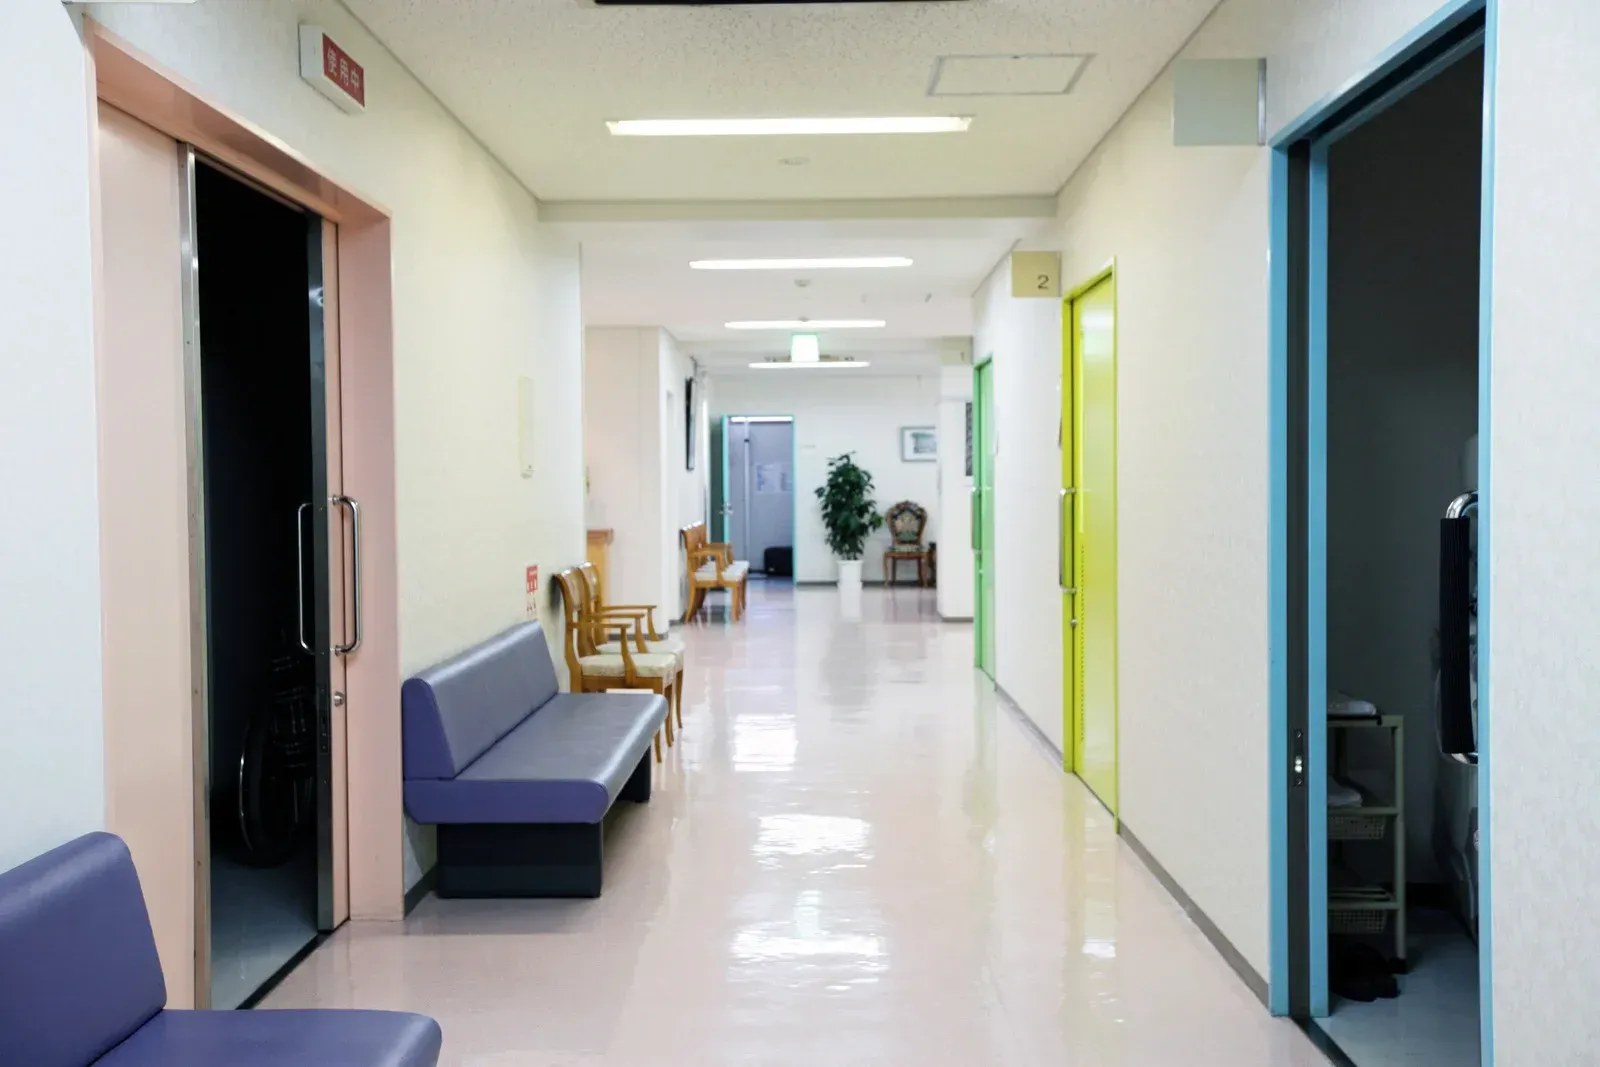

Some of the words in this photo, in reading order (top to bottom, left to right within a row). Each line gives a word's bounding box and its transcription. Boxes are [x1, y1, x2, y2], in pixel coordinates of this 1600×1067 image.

[326, 45, 360, 92] 使用中
[1037, 274, 1049, 290] 2
